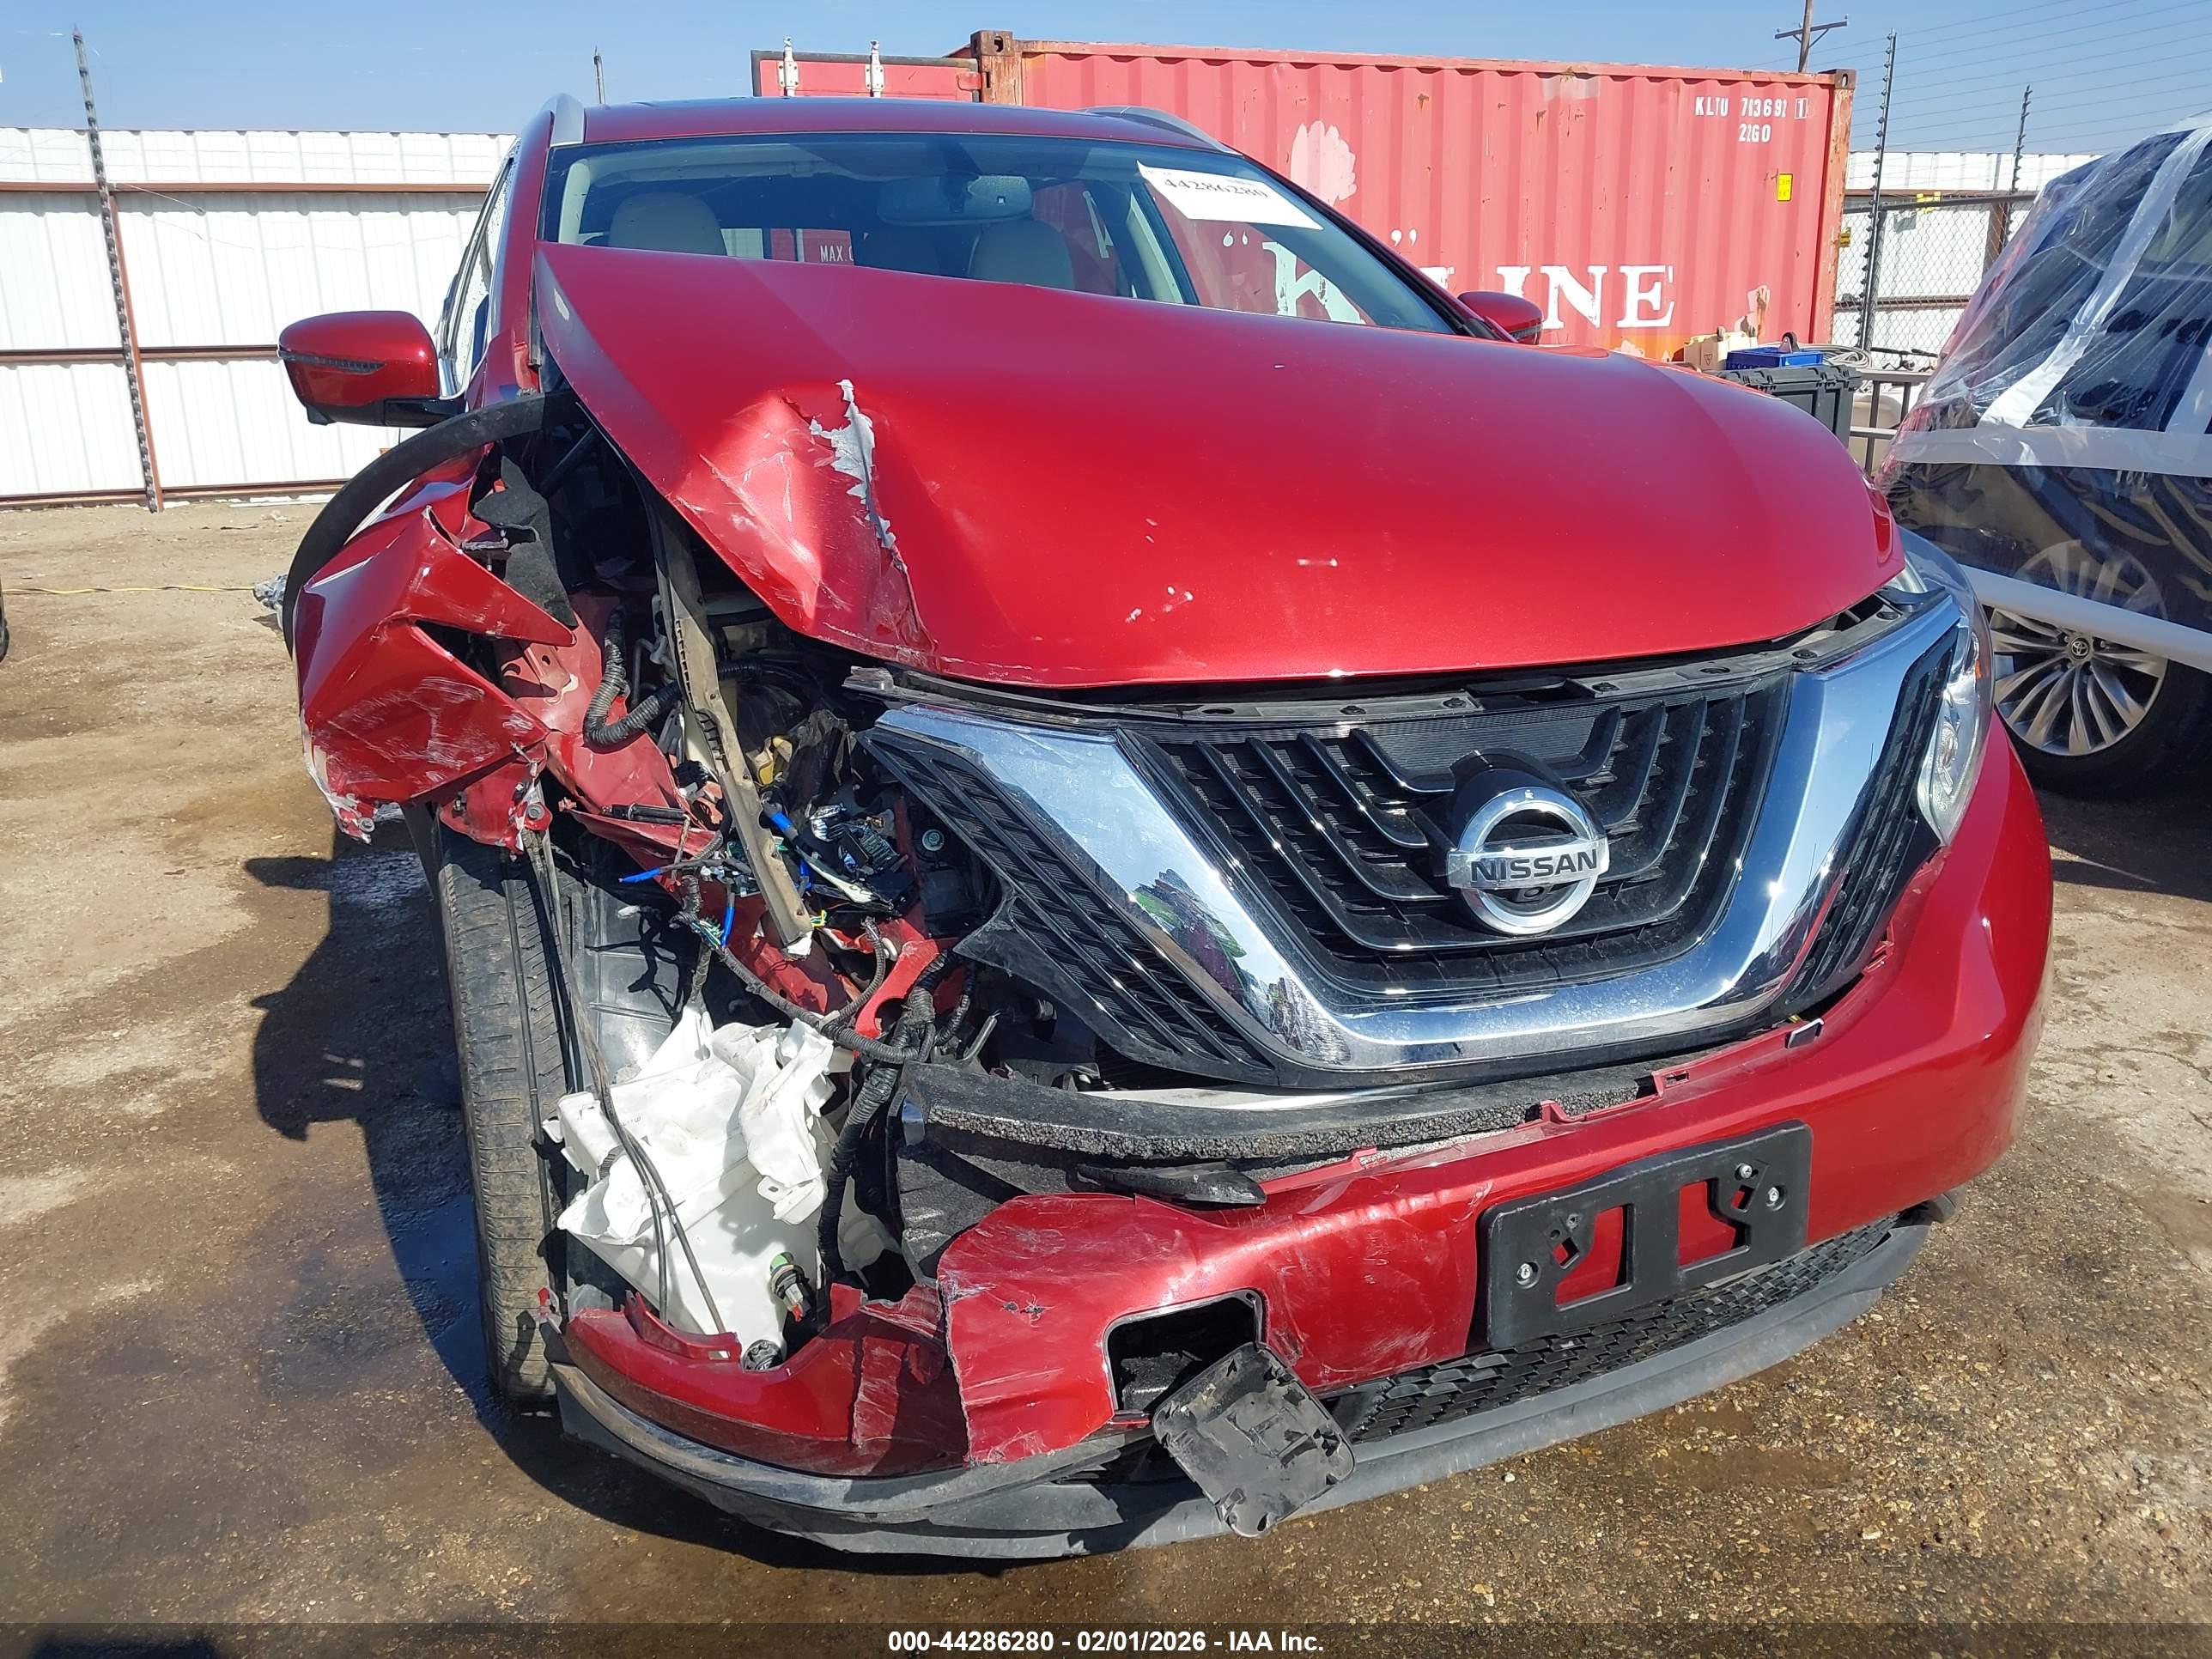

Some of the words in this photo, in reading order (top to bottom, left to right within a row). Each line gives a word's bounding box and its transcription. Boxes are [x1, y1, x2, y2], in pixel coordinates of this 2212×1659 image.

[1694, 96, 1729, 117] KLTU
[1164, 179, 1268, 198] 44286280
[1470, 848, 1598, 882] NISSAN
